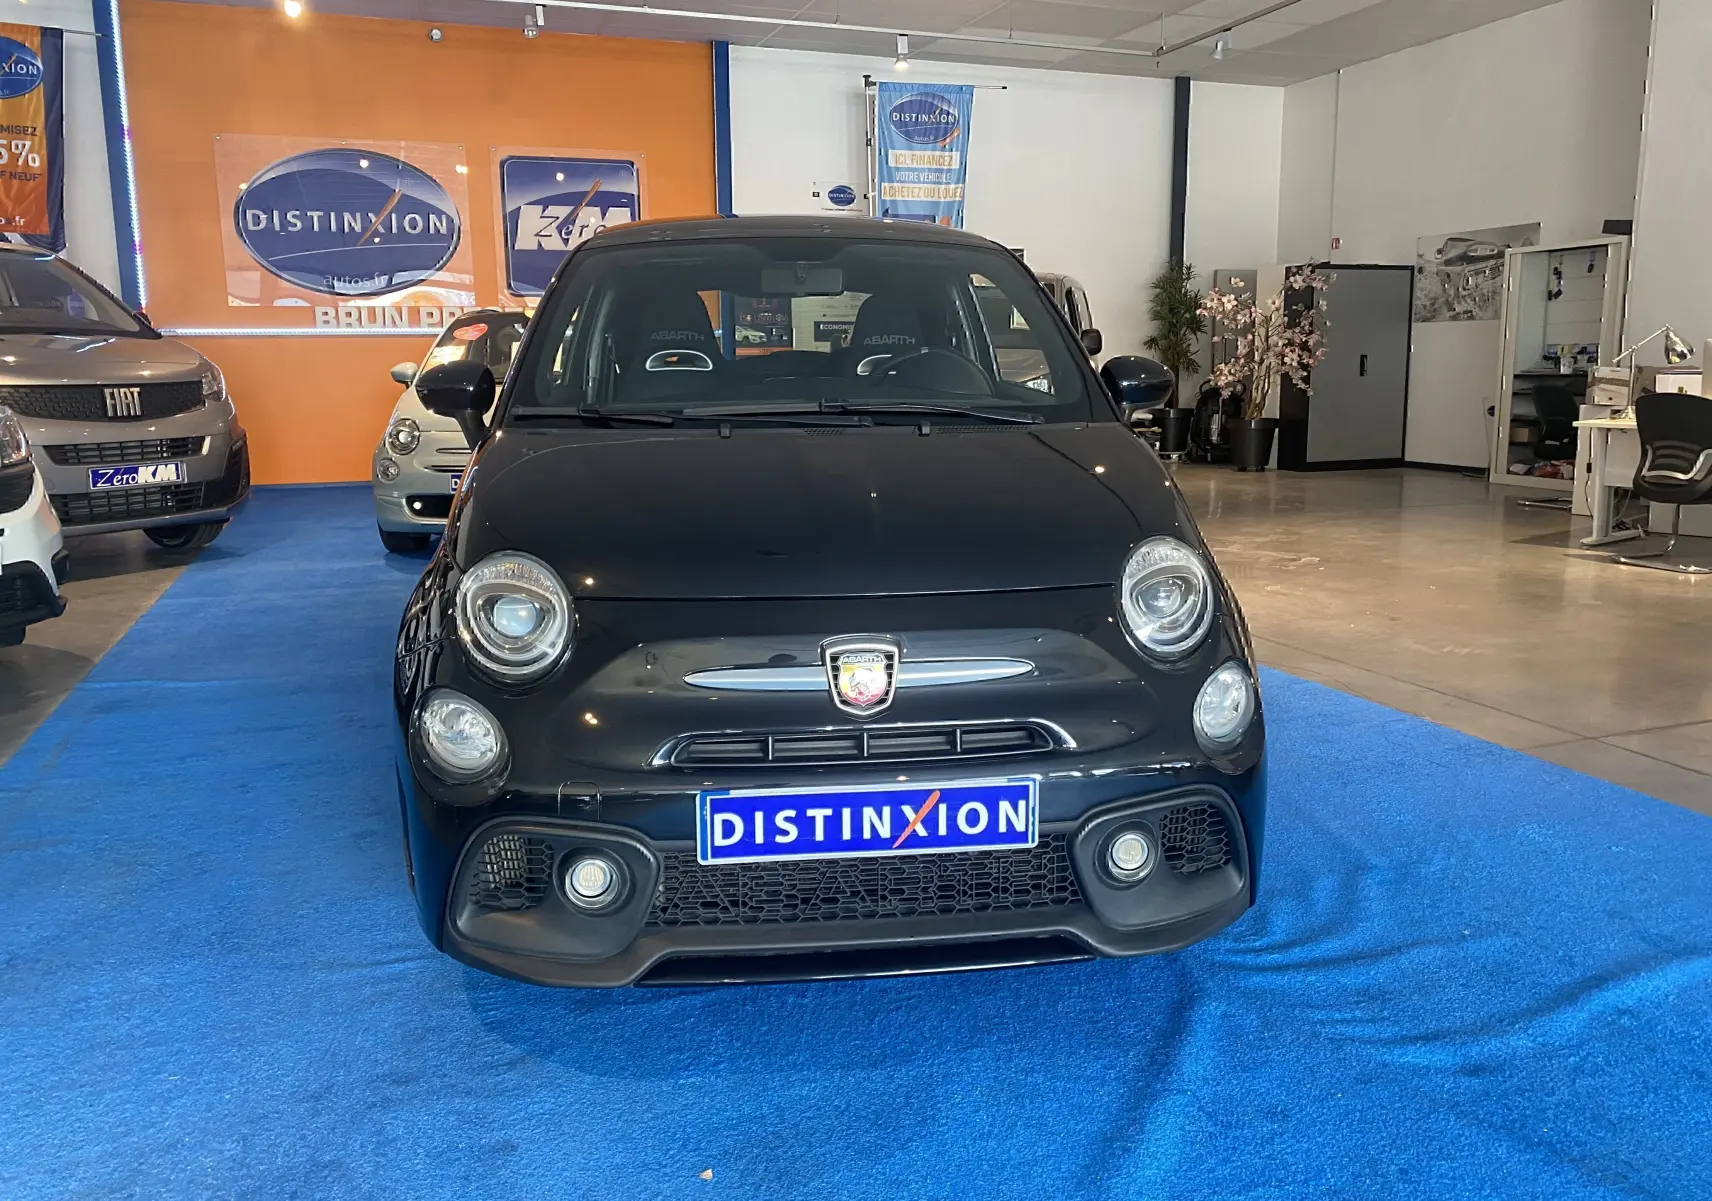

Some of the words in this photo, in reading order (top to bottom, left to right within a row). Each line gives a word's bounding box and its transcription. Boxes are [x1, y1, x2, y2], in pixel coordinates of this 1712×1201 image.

[893, 112, 955, 123] DISTINXION
[911, 154, 953, 167] FINANCEZ
[896, 171, 919, 182] VOTRE
[920, 169, 952, 182] VÉHICULE
[883, 186, 921, 198] ACHETEZ
[924, 187, 935, 198] OU
[938, 187, 963, 200] LOUEZ
[246, 208, 448, 235] DISTINXION
[323, 272, 387, 288] autos.fr
[315, 306, 408, 329] BRUN
[650, 330, 704, 341] ABARTH
[863, 334, 915, 345] ABARTH
[104, 387, 142, 417] FIAT
[842, 655, 882, 663] ABARTH
[713, 798, 1027, 848] DISTINXION
